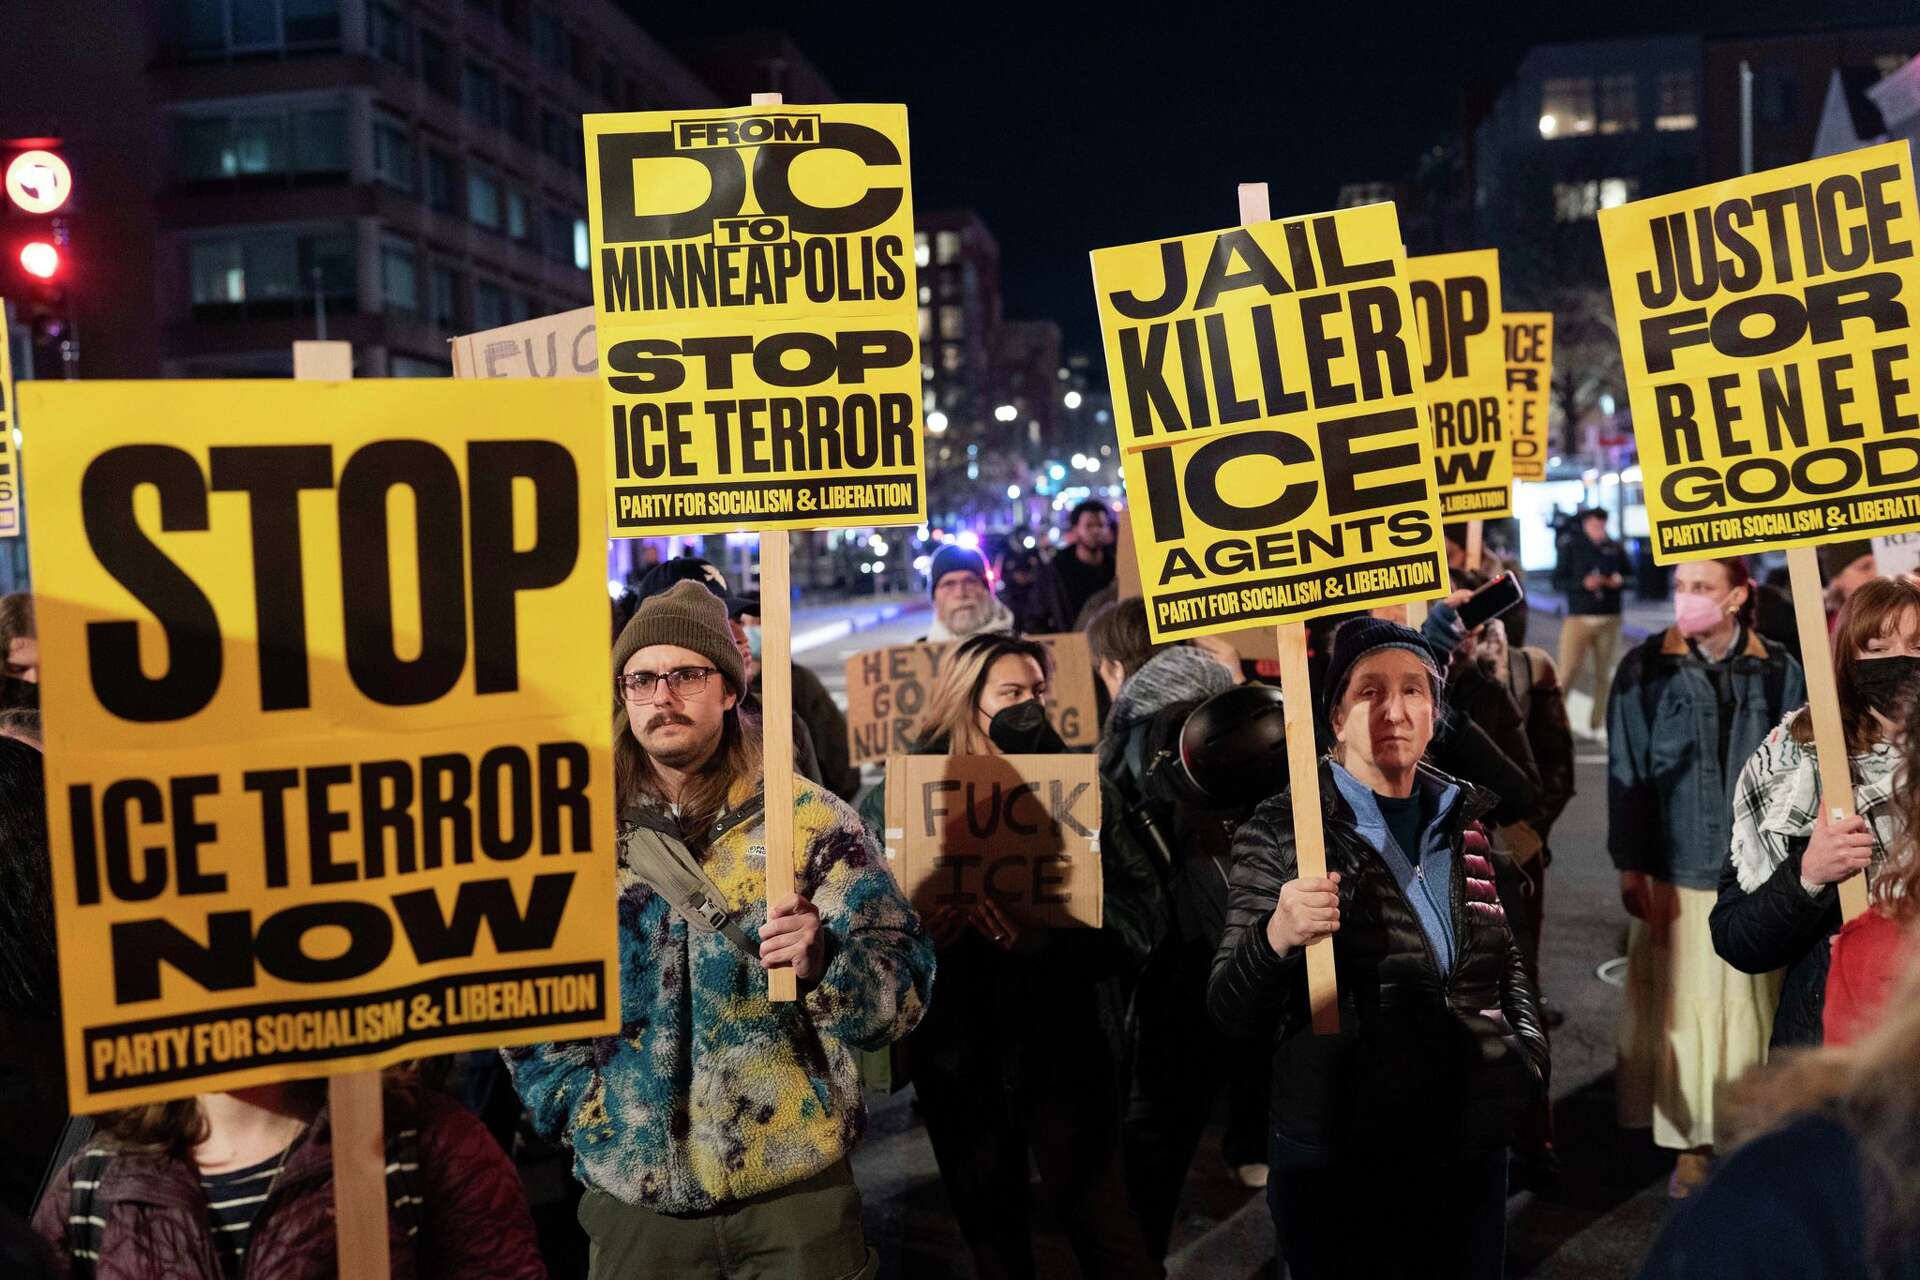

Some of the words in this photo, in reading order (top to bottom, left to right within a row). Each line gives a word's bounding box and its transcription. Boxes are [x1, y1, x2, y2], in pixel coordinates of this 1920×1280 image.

[680, 119, 813, 147] FROM
[718, 219, 785, 243] TO
[1109, 216, 1395, 320] JAIL
[1637, 164, 1914, 309] JUSTICE
[602, 235, 905, 312] MINNEAPOLIS
[485, 324, 598, 378] FUC
[1409, 276, 1490, 382] OP
[1640, 272, 1910, 374] FOR
[608, 329, 914, 394] STOP
[1118, 285, 1413, 438] KILLER
[613, 401, 698, 479] ICE
[704, 393, 915, 475] TERROR
[1428, 397, 1501, 448] ROR
[1655, 344, 1920, 466] RENEE
[621, 494, 672, 519] PARTY
[675, 492, 706, 517] FOR
[709, 488, 792, 514] SOCIALISM
[797, 489, 817, 511] &
[820, 483, 911, 509] LIBERATION
[1142, 407, 1428, 543] ICE
[1660, 437, 1920, 512] GOOD
[1158, 510, 1433, 586] AGENTS
[1662, 523, 1712, 548] PARTY
[1712, 518, 1743, 540] FOR
[1743, 508, 1823, 537] SOCIALISM
[1826, 506, 1848, 527] &
[1849, 495, 1920, 523] LIBERATI
[81, 439, 580, 722] STOP
[1158, 599, 1208, 625] PARTY
[1209, 592, 1240, 616] FOR
[1241, 582, 1321, 611] SOCIALISM
[1325, 577, 1344, 598] &
[1346, 561, 1434, 595] LIBERATION
[863, 644, 946, 685] HEY
[67, 774, 228, 906] ICE
[244, 741, 593, 888] TERROR
[922, 779, 1093, 838] FUCK
[933, 854, 1072, 904] ICE
[110, 871, 576, 1005] NOW
[93, 1030, 200, 1081] PARTY
[195, 1022, 253, 1065] FOR
[256, 1000, 403, 1054] SOCIALISM
[408, 994, 443, 1030] &
[445, 973, 597, 1024] LIBERATION
